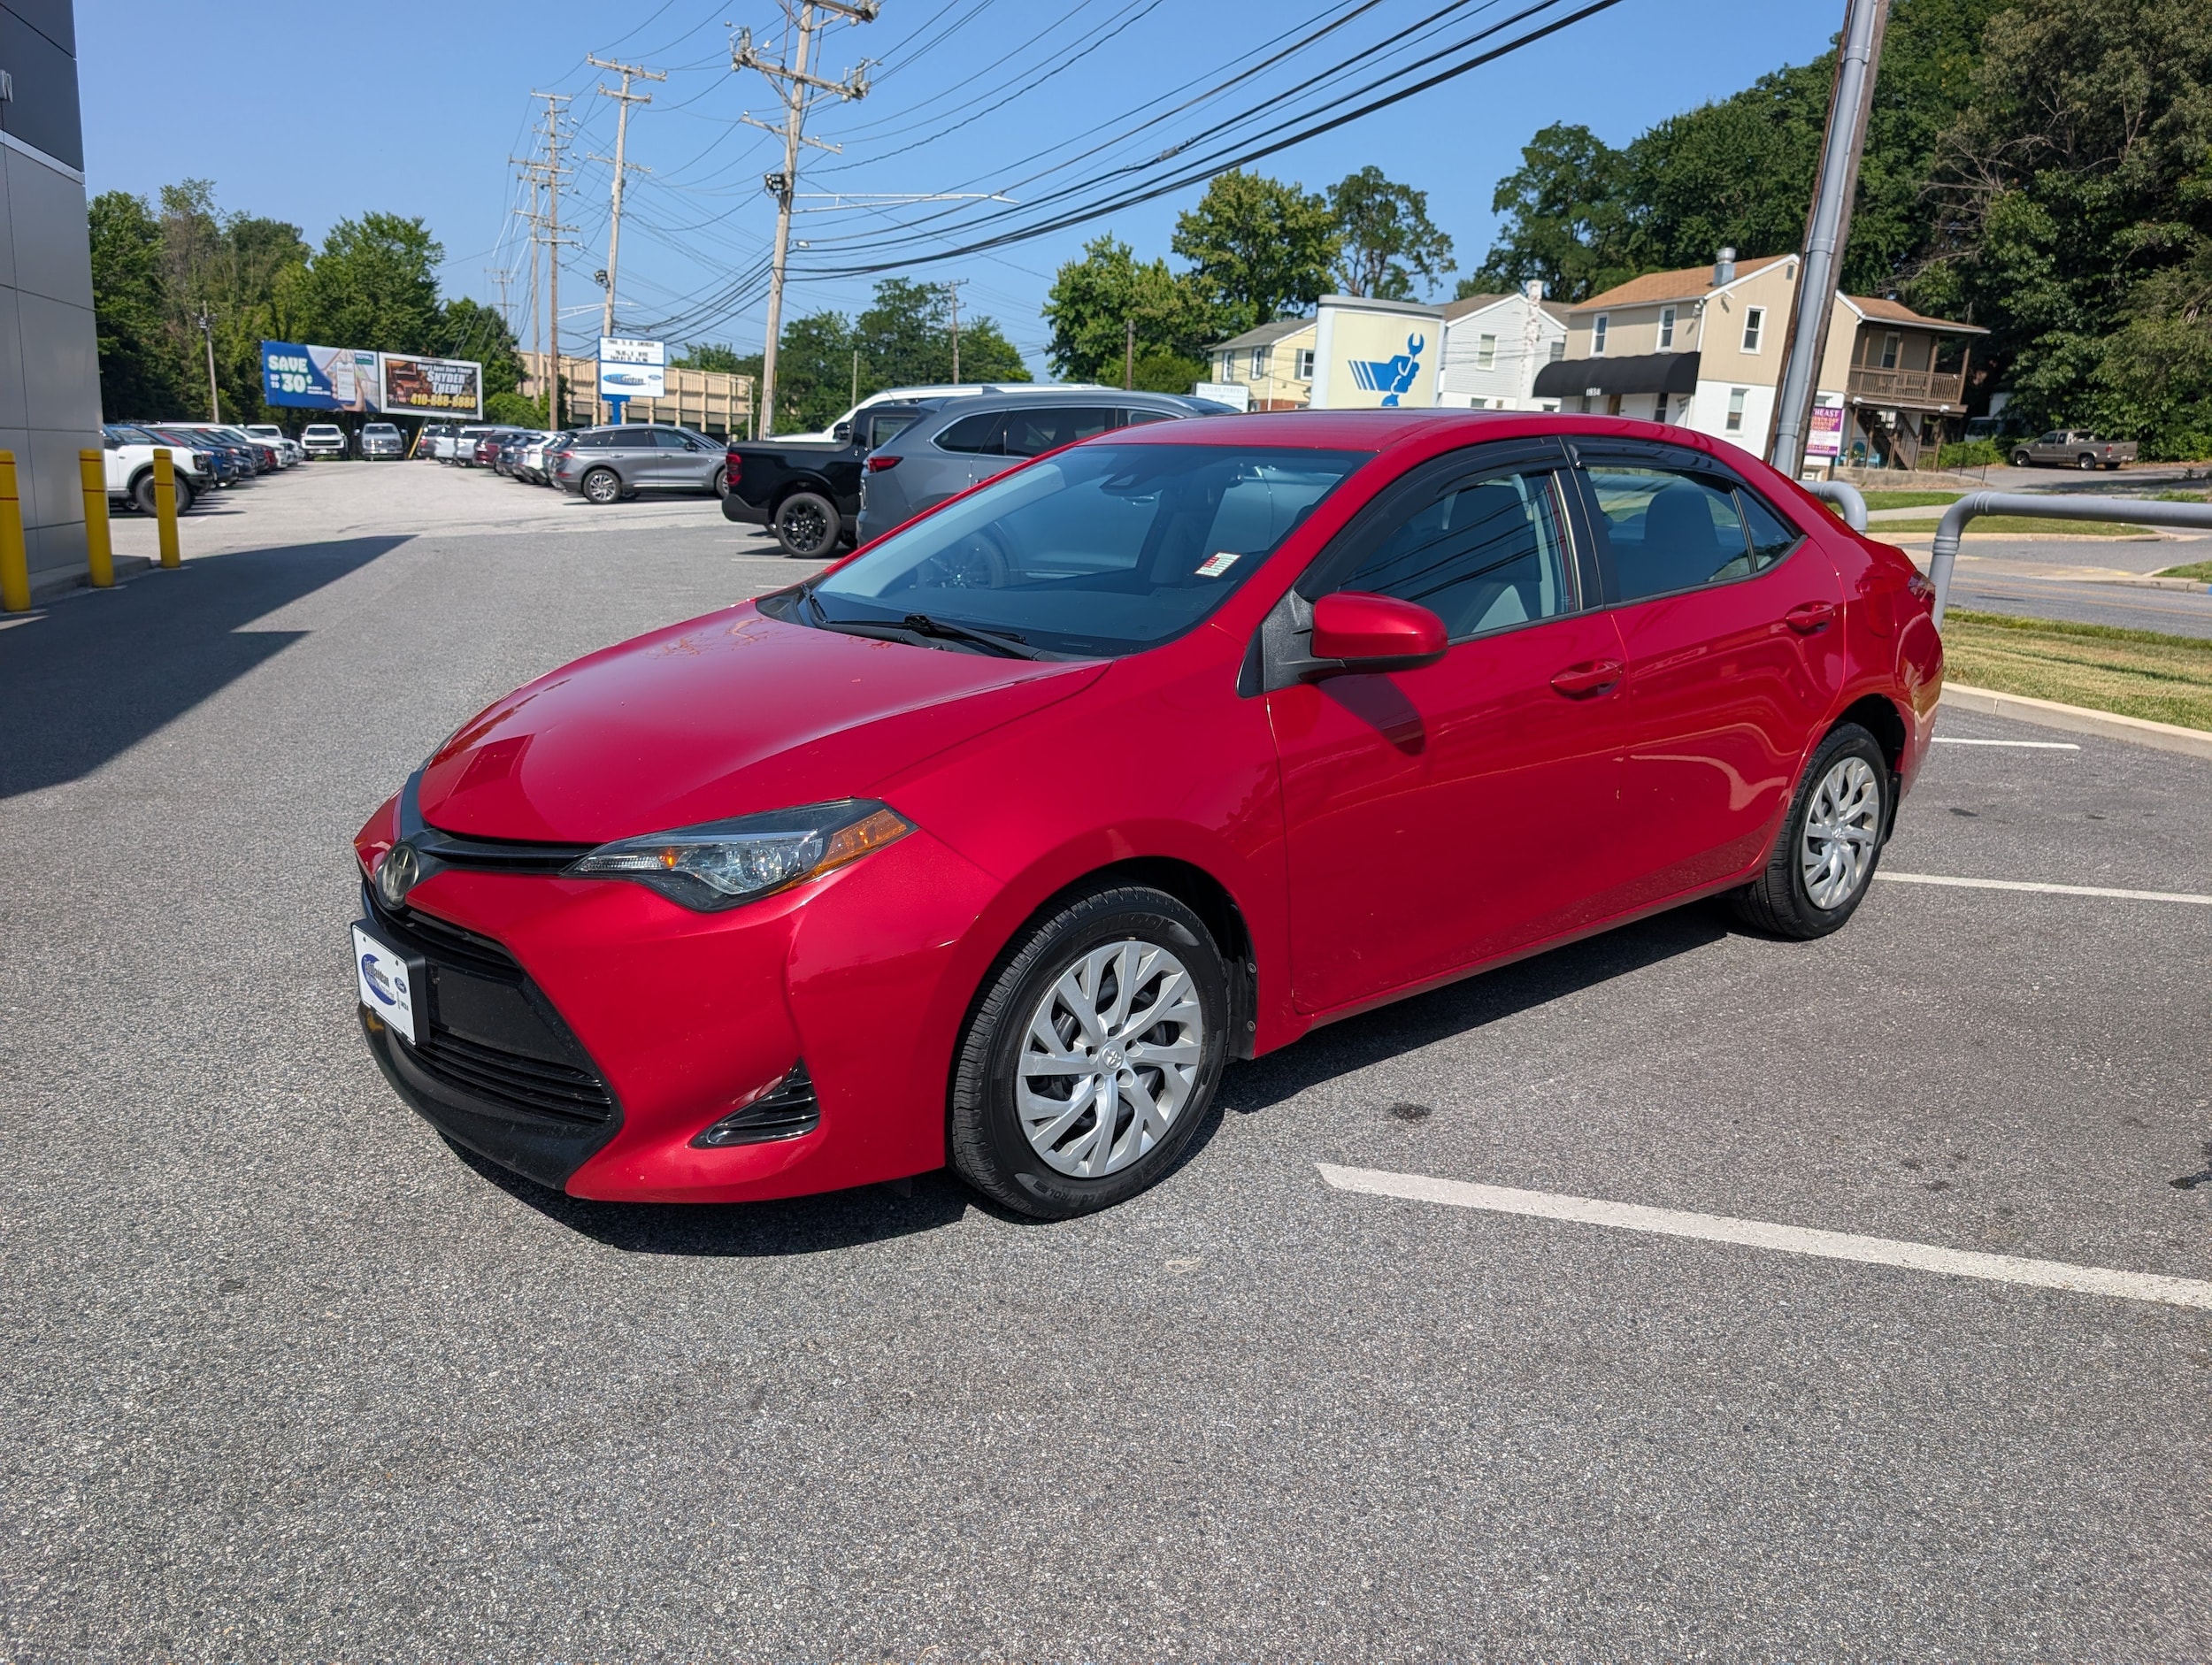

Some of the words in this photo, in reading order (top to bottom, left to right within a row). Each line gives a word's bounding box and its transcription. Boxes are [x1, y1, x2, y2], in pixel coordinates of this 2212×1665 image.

[268, 355, 308, 372] SAVE
[426, 371, 465, 384] SNYDER
[432, 382, 463, 395] THEM!
